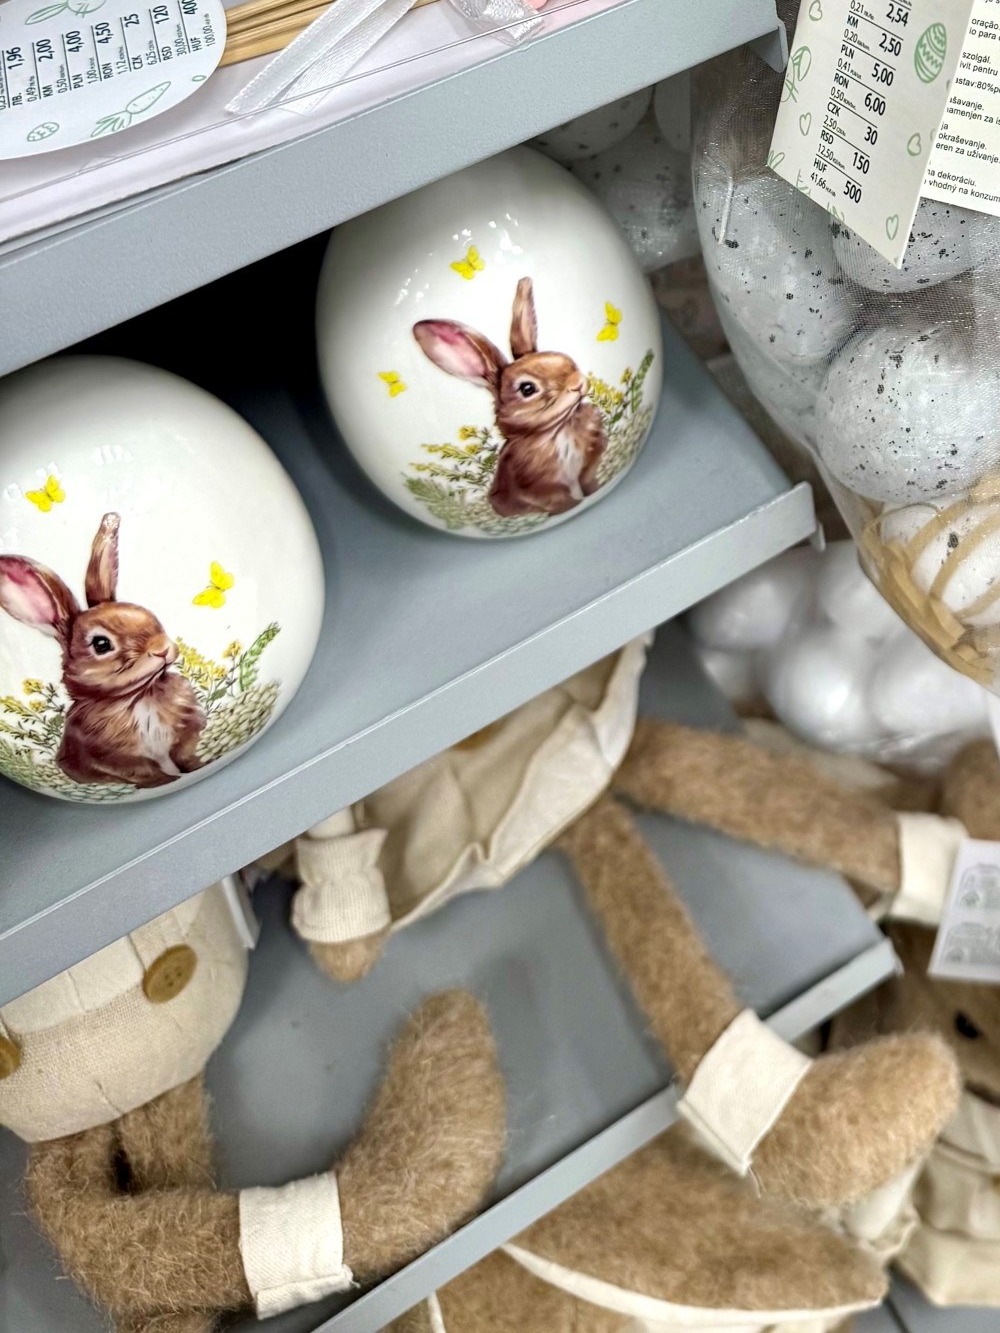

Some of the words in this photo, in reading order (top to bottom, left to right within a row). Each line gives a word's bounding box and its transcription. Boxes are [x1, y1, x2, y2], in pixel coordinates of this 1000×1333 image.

[124, 13, 140, 28] 25
[152, 5, 170, 25] 120
[886, 3, 910, 27] 2,54
[65, 30, 84, 53] 4,00
[95, 22, 114, 44] 4,50
[847, 14, 859, 28] KM
[879, 32, 902, 56] 2,50
[978, 30, 997, 40] para
[36, 38, 55, 62] 2,00
[161, 46, 173, 61] RSD
[190, 37, 202, 52] HUF
[6, 46, 25, 70] 1,96
[132, 54, 144, 70] CZK
[840, 44, 855, 59] PLN
[871, 62, 894, 86] 5,00
[102, 62, 114, 79] RON
[972, 65, 998, 76] pentru
[43, 84, 53, 97] KM
[72, 73, 84, 89] PLN
[833, 72, 849, 89] RON
[864, 92, 886, 116] 6,00
[826, 101, 841, 117] CZK
[864, 126, 878, 145] 30
[984, 115, 994, 123] za
[820, 129, 834, 145] RSD
[852, 151, 870, 174] 150
[813, 157, 828, 173] HUF
[843, 180, 862, 203] 500
[959, 186, 968, 194] na
